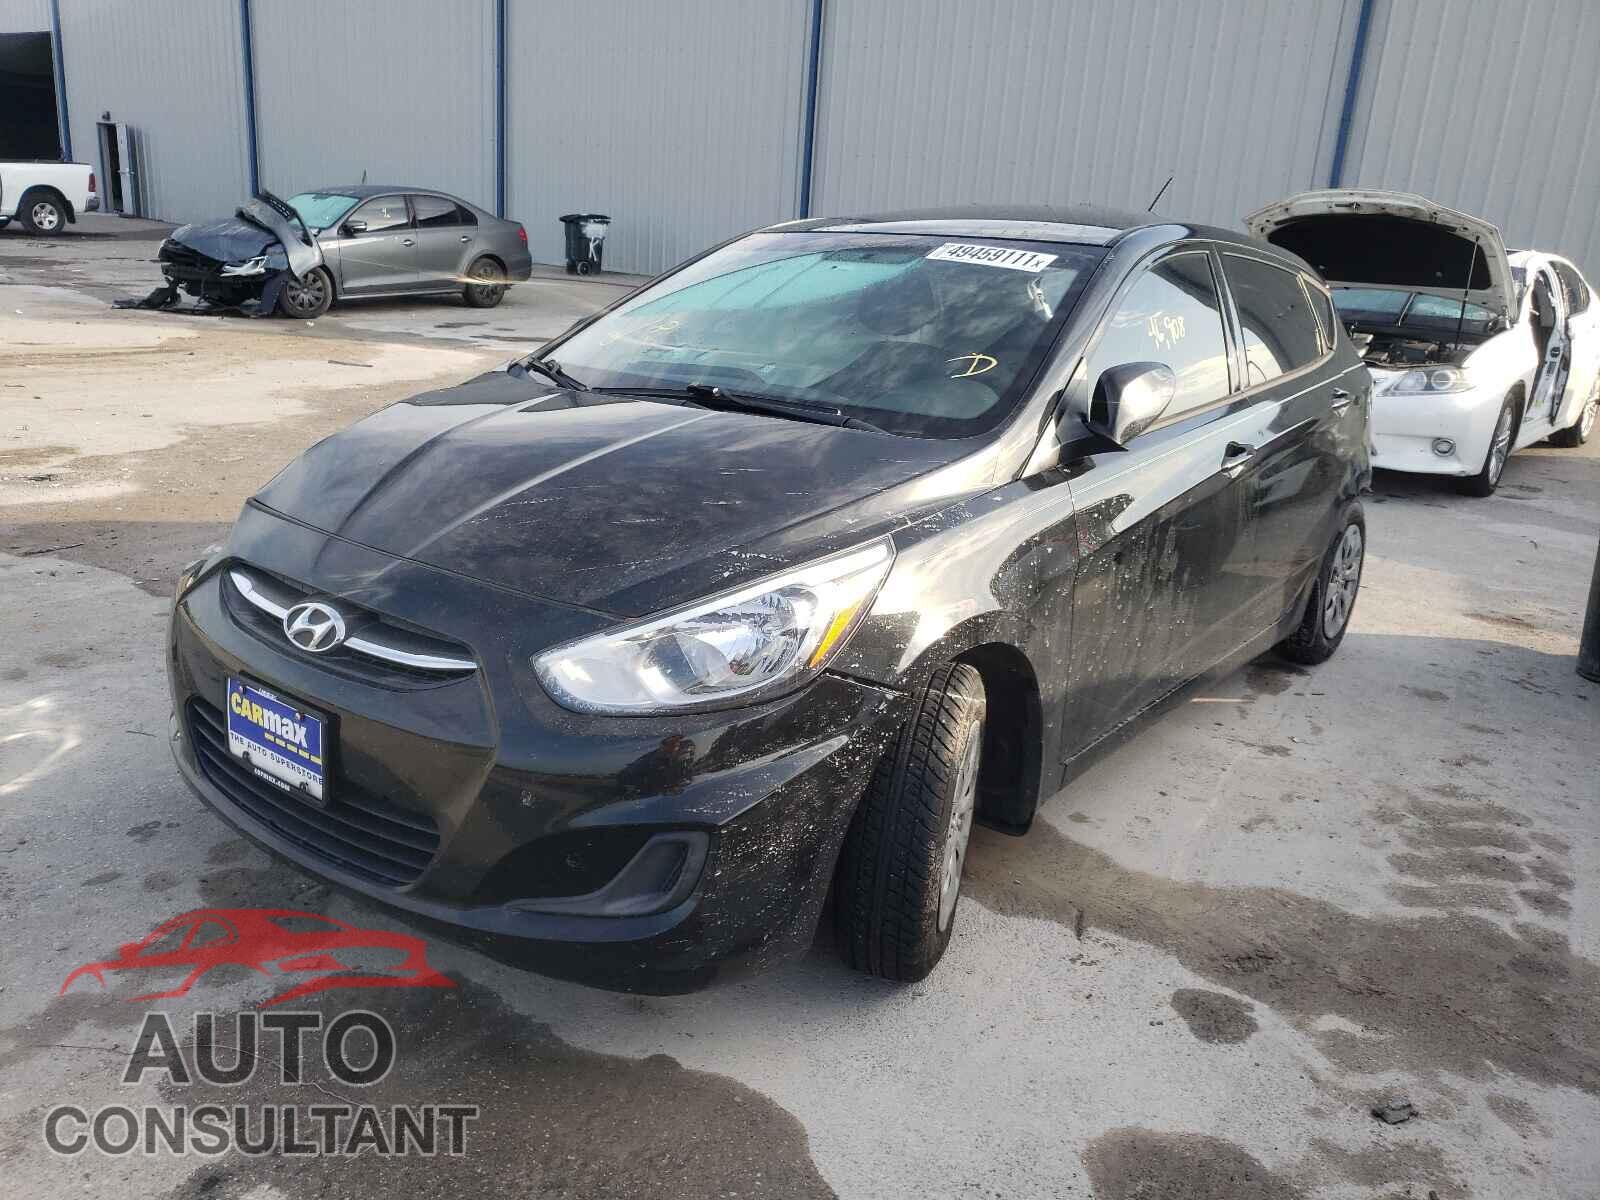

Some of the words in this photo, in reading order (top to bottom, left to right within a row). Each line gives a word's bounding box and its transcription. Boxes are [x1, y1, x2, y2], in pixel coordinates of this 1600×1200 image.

[945, 352, 998, 379] D
[230, 732, 244, 746] THE
[247, 742, 268, 757] AUTO
[270, 753, 323, 785] SUPERSTORE
